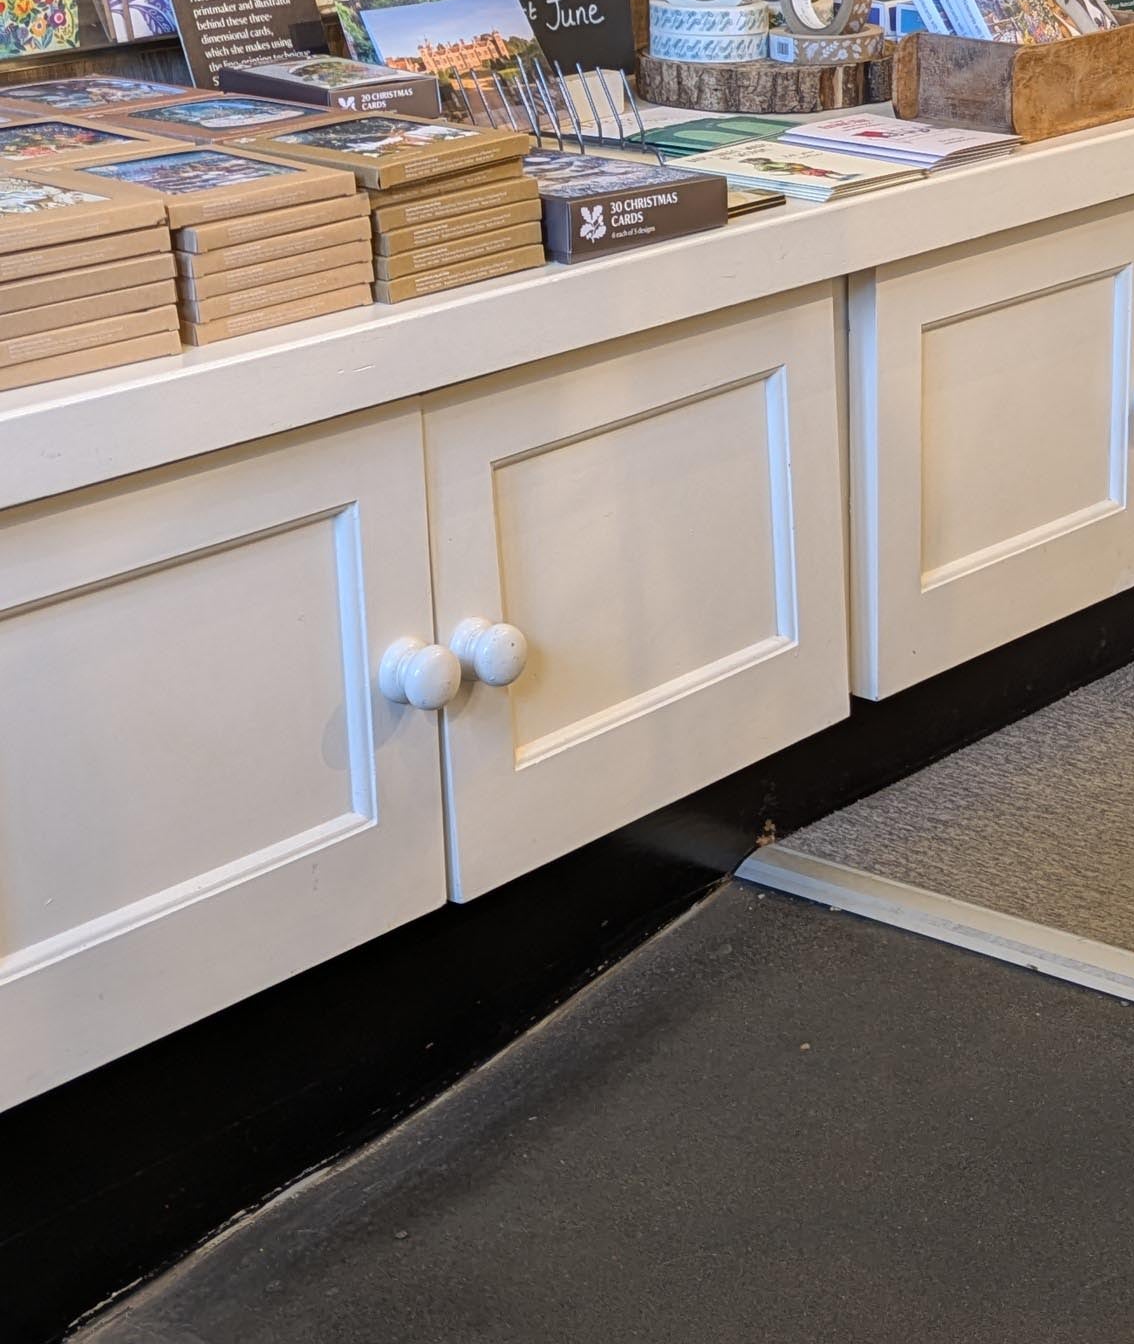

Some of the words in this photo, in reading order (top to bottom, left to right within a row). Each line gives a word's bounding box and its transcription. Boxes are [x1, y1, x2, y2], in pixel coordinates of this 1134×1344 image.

[193, 4, 236, 18] printmaker
[238, 0, 253, 10] and
[196, 19, 225, 31] behind
[226, 16, 248, 26] these
[201, 29, 252, 44] dimensional
[252, 26, 274, 37] cards,
[204, 46, 229, 59] which
[230, 44, 245, 54] she
[246, 40, 270, 52] makes
[271, 37, 293, 48] using
[361, 93, 371, 102] 20
[372, 88, 413, 101] CHRISTMAS
[361, 101, 386, 110] CARDS
[610, 201, 622, 214] 30
[624, 192, 678, 211] CHRISTMAS
[611, 212, 644, 227] CARDS
